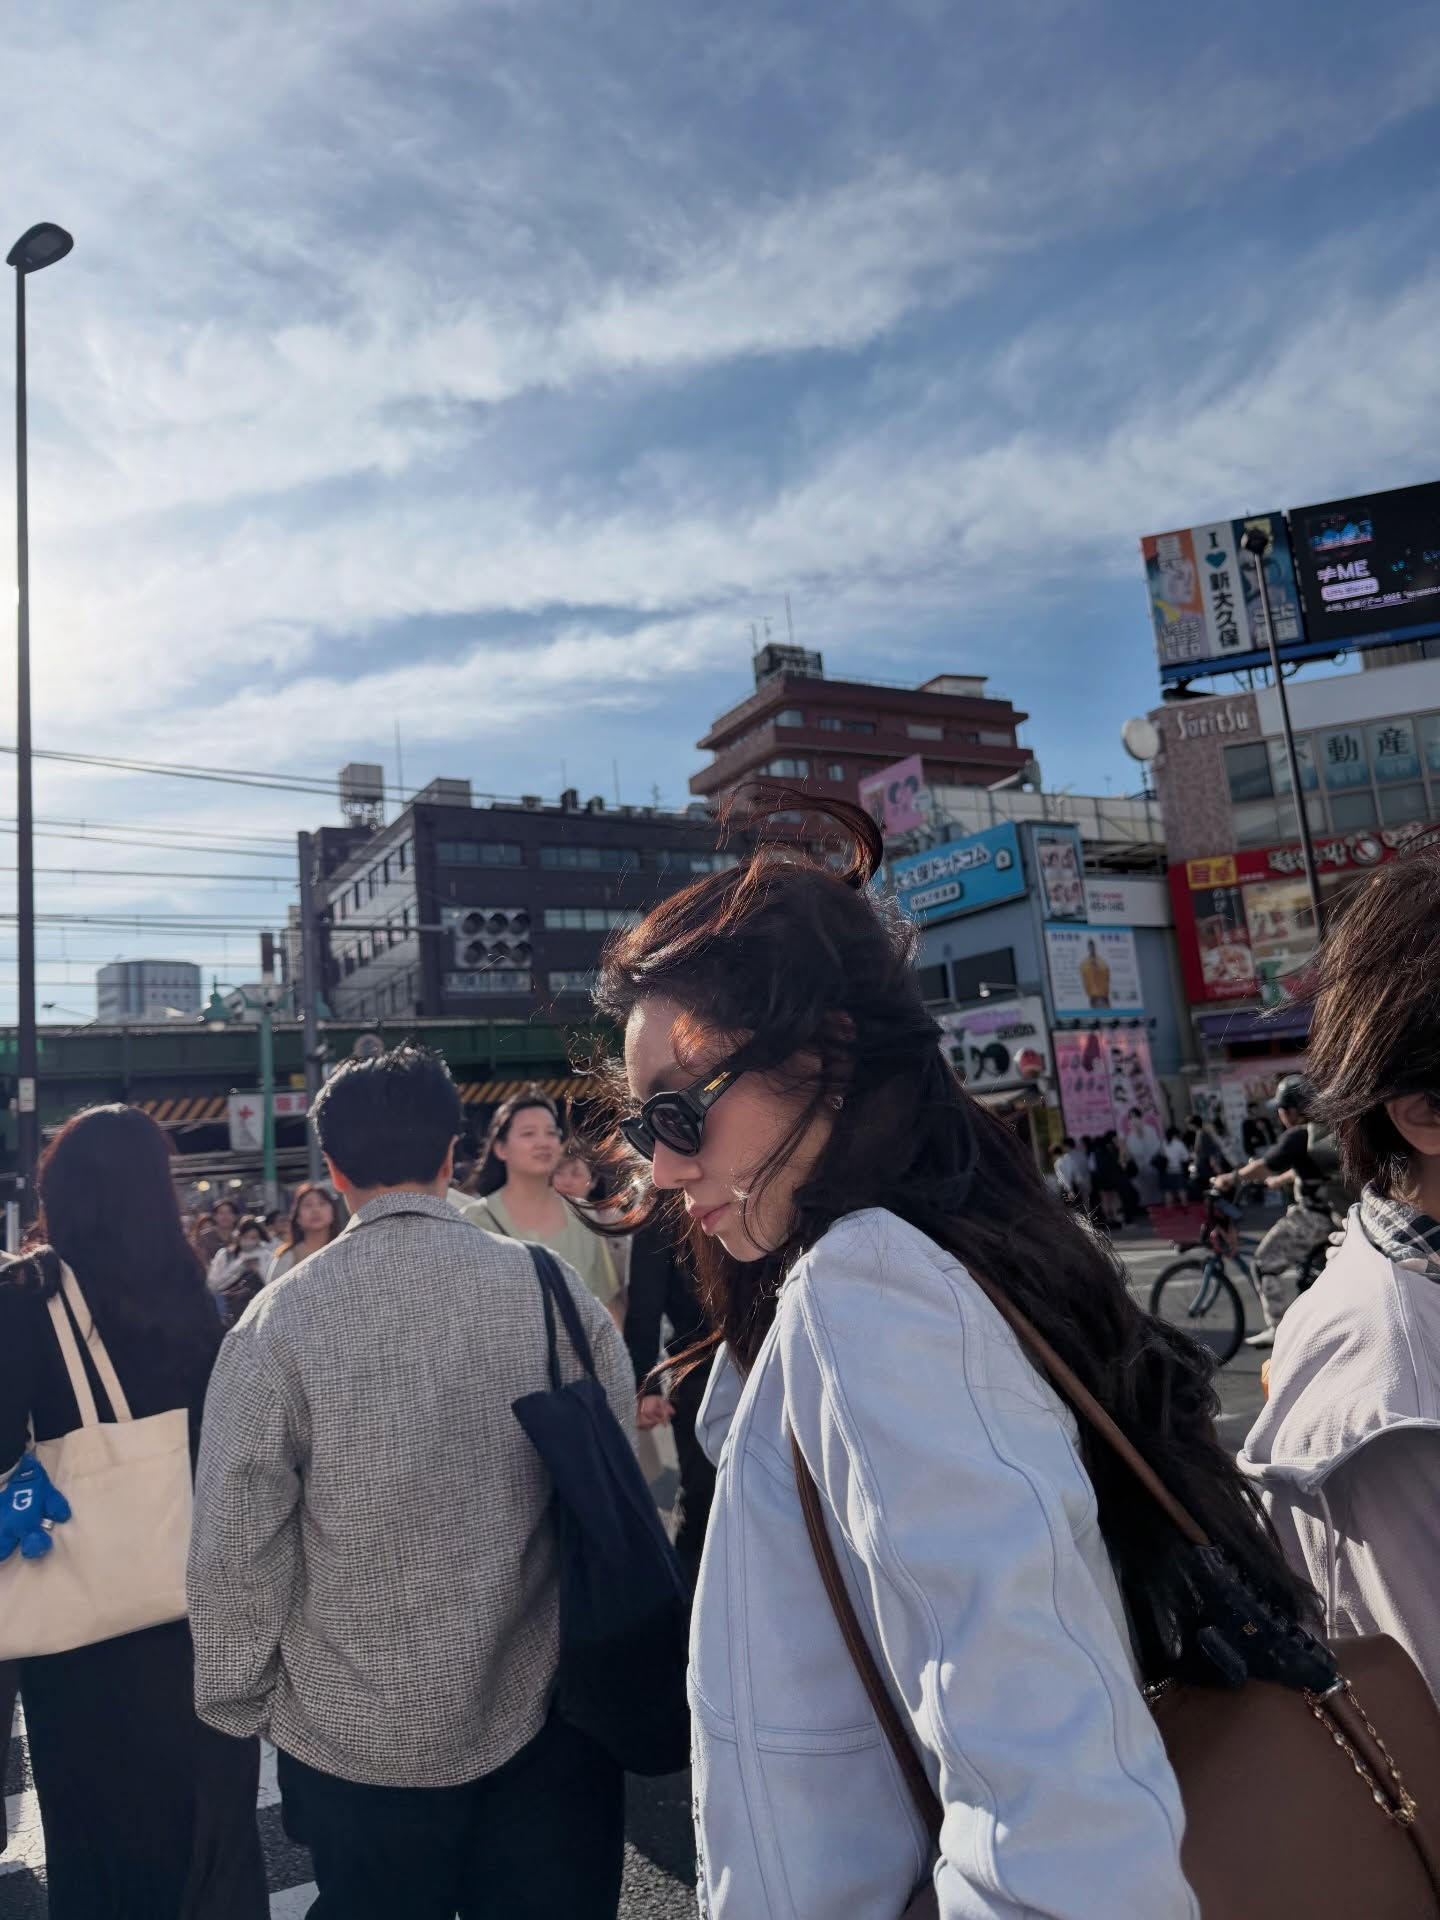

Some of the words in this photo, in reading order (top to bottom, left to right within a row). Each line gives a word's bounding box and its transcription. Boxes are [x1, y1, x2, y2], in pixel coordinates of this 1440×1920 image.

[1208, 532, 1218, 548] I
[1209, 570, 1240, 649] 新大久保
[12, 1488, 33, 1511] G
